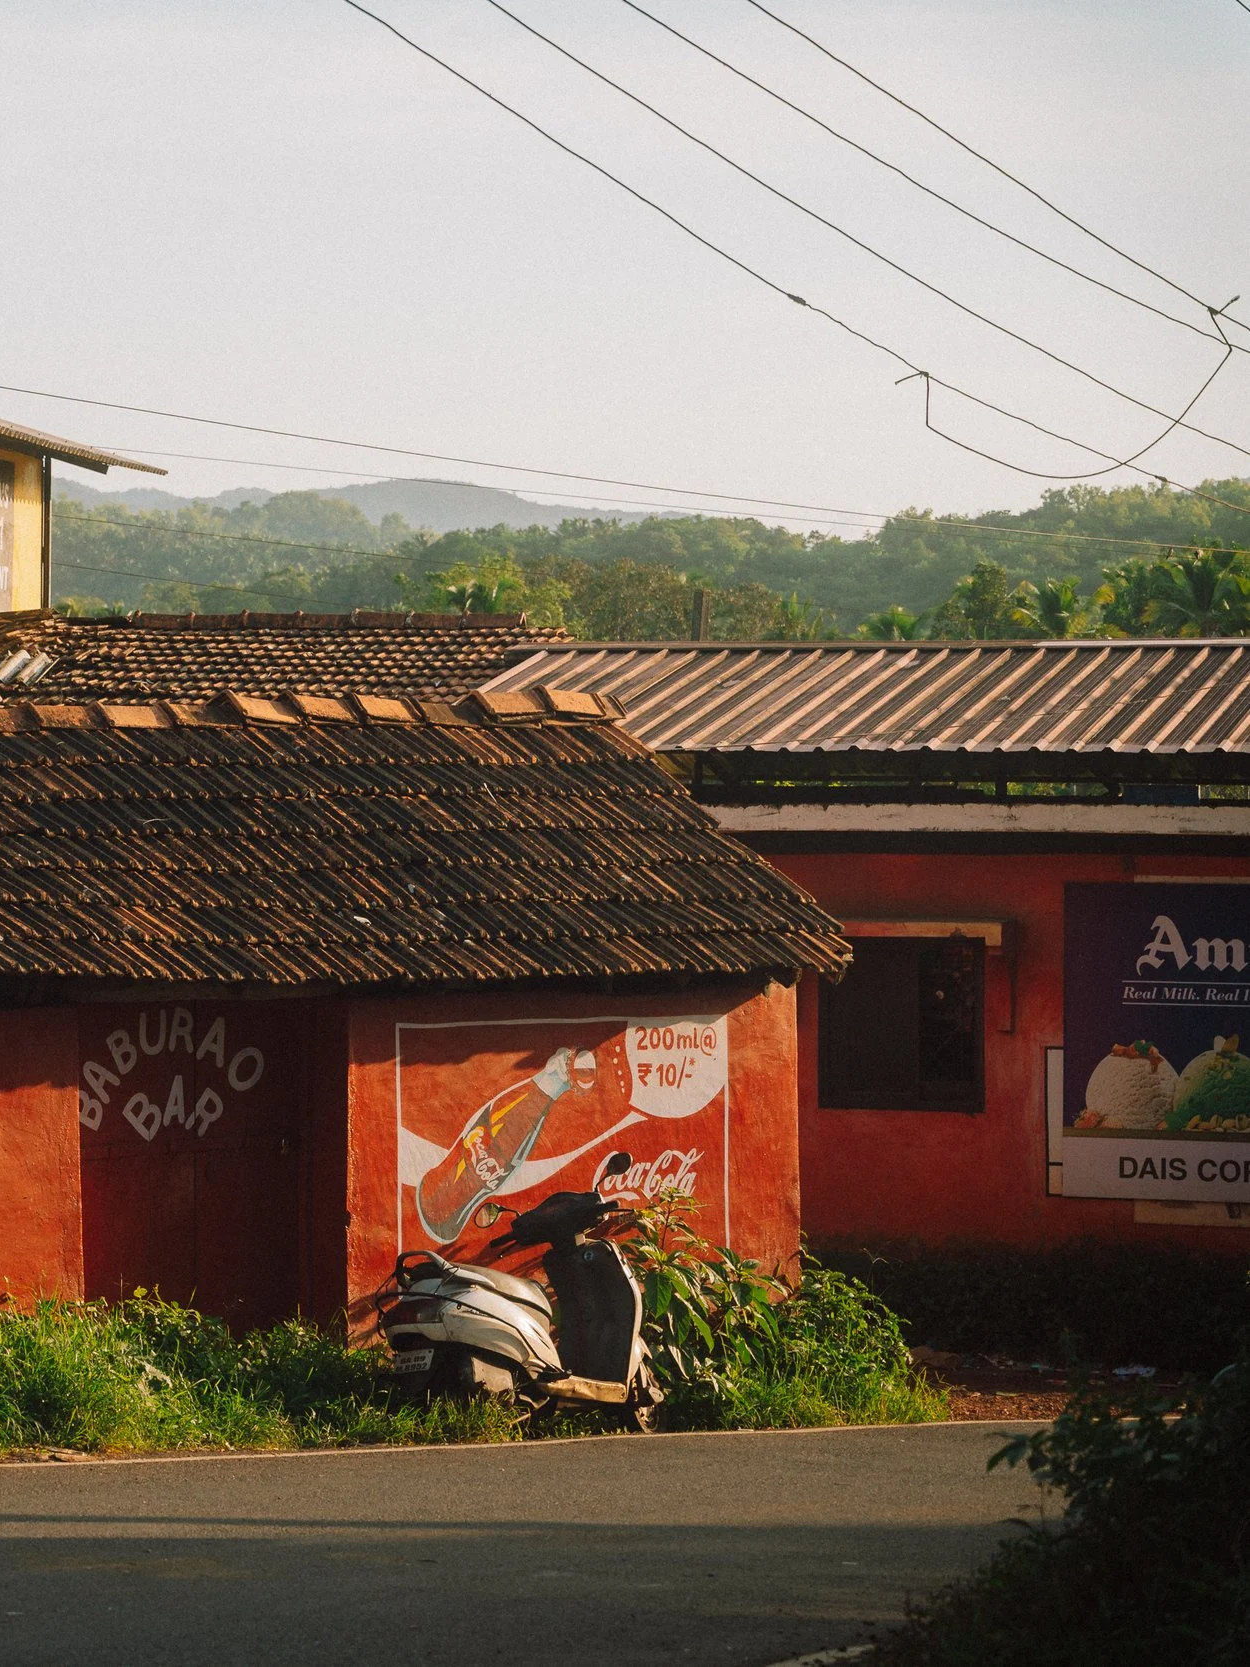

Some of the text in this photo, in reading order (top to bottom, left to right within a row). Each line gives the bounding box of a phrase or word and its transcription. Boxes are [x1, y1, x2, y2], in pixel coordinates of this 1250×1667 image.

[1135, 914, 1250, 977] Am
[1122, 986, 1158, 1001] Real
[1161, 986, 1201, 1001] Milk.
[1205, 987, 1241, 1002] Real
[79, 1007, 265, 1132] BABURAO
[121, 1074, 224, 1143] BAR
[1118, 1156, 1188, 1181] DAIS
